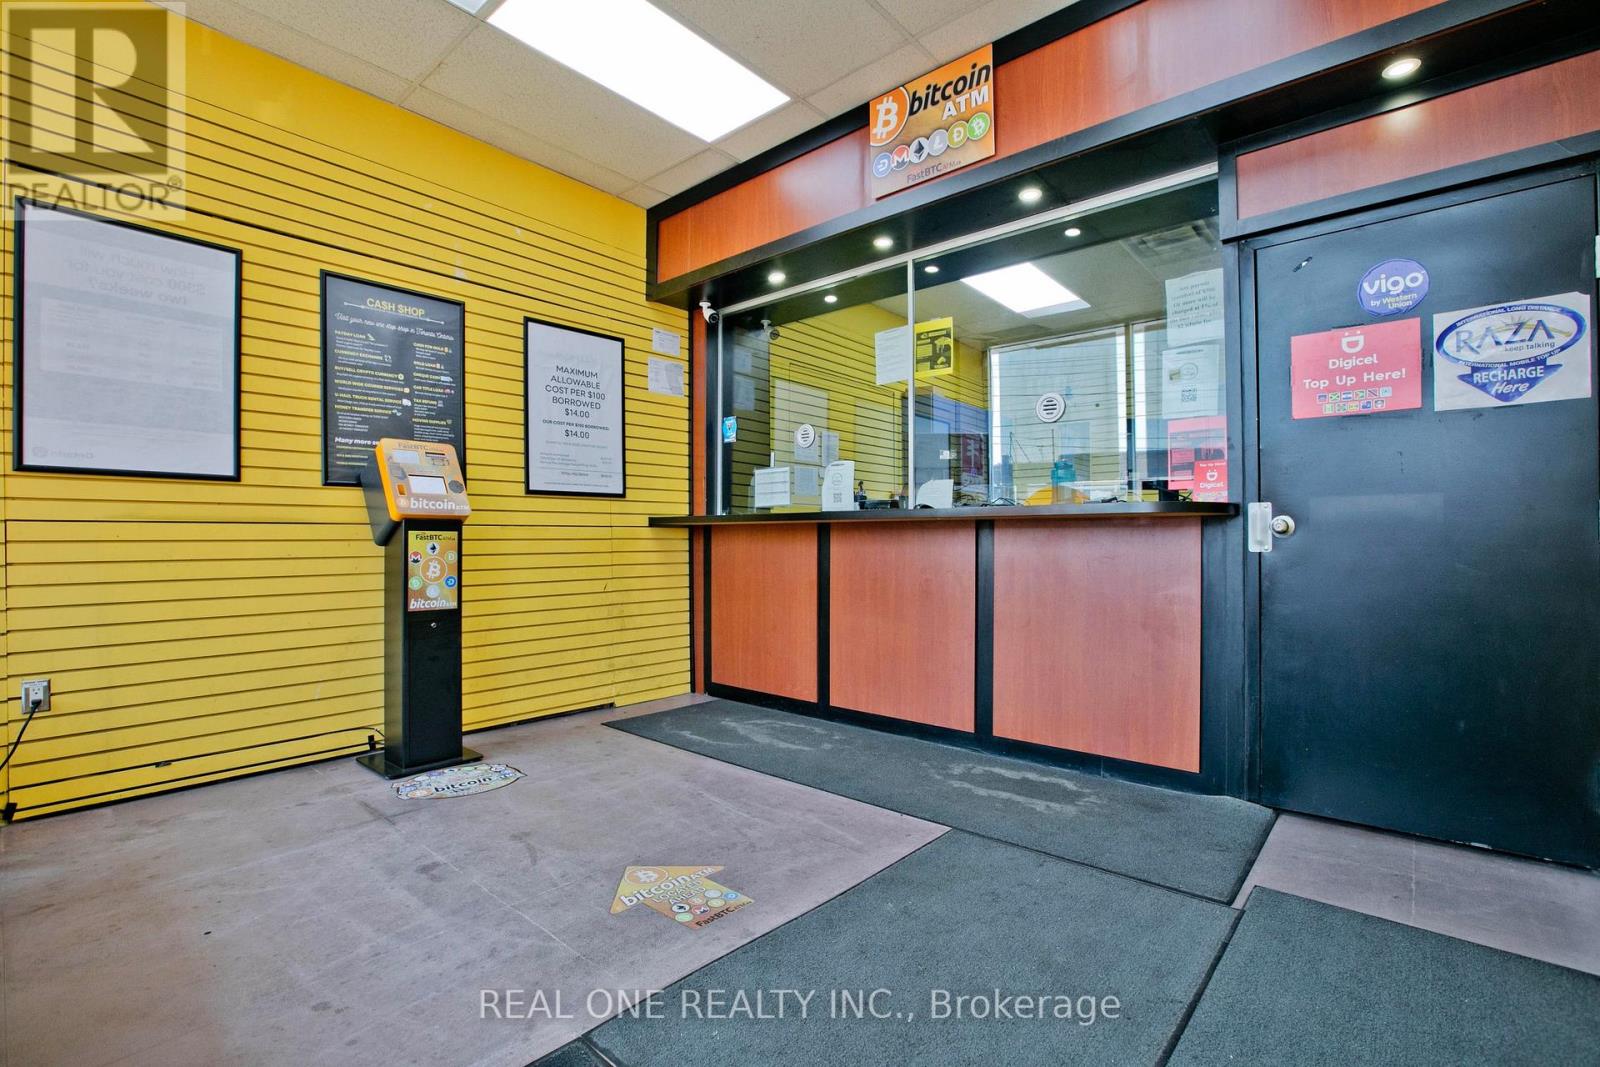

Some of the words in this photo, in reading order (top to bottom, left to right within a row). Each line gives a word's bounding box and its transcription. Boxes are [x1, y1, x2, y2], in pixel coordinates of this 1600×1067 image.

[910, 63, 991, 116] bitcoin
[942, 85, 989, 121] ATM
[1363, 272, 1424, 295] vigo
[1370, 299, 1380, 307] by
[1382, 293, 1418, 305] Western
[1388, 300, 1412, 309] Union
[1455, 306, 1506, 327] INTERNATIONAL
[1507, 305, 1527, 313] LONG
[1455, 319, 1555, 355] RAZA
[1505, 345, 1525, 354] keep
[1526, 341, 1556, 351] talking
[1328, 354, 1378, 370] Digicel
[1509, 358, 1536, 367] MOBILE
[1537, 352, 1549, 361] TOP
[1549, 348, 1561, 357] UP
[556, 365, 598, 379] MAXIMUM
[1303, 379, 1329, 389] Top
[1336, 375, 1356, 386] Up
[1363, 368, 1406, 382] Here!
[1473, 366, 1545, 384] RECHARGE
[551, 375, 600, 390] ALLOWABLE
[1492, 382, 1530, 395] Here
[545, 384, 569, 394] COST
[570, 388, 586, 397] PER
[588, 391, 606, 401] $100
[552, 396, 601, 410] BORROWED
[565, 408, 590, 418] $14.00
[335, 437, 354, 445] Many
[565, 429, 590, 439] $14.00
[1199, 481, 1225, 490] Digicel
[410, 498, 456, 510] bitcoin
[410, 598, 446, 609] bitcoin
[434, 777, 492, 793] bitcoin
[620, 875, 691, 906] bitcoin
[692, 866, 715, 880] ATM
[654, 878, 706, 903] LOCATED
[669, 886, 706, 905] AHEAD
[695, 907, 735, 928] FastBTC
